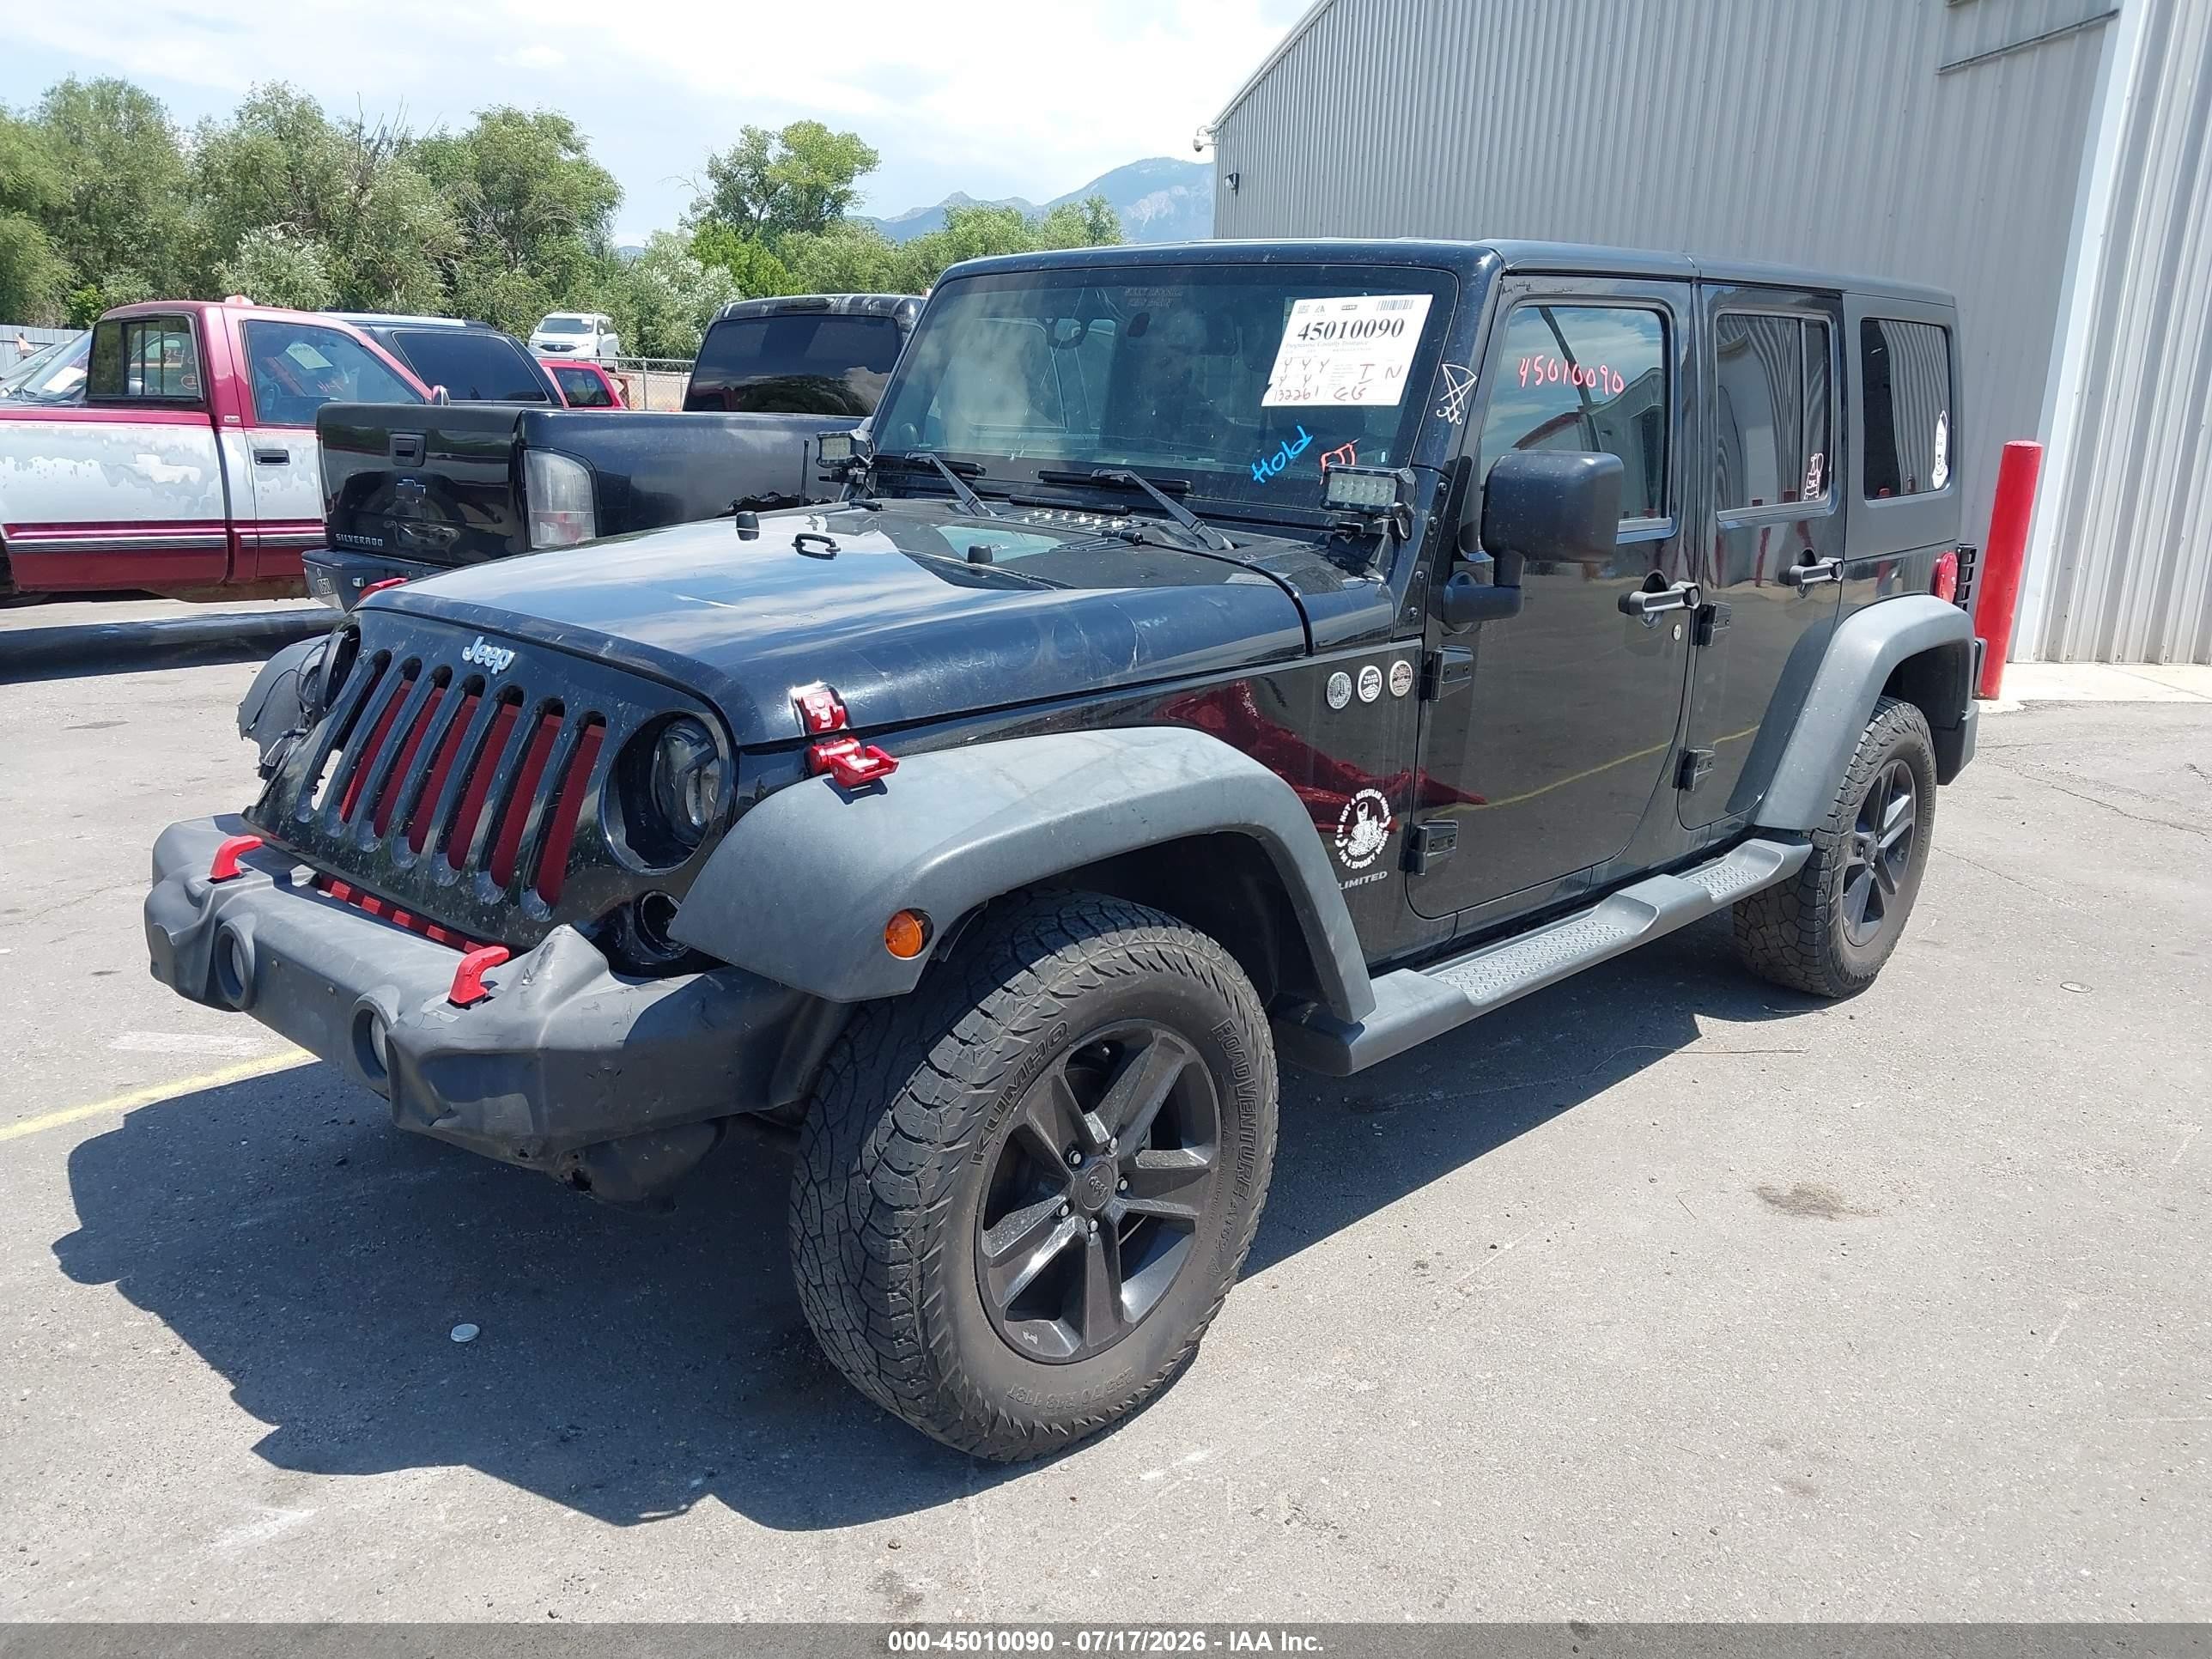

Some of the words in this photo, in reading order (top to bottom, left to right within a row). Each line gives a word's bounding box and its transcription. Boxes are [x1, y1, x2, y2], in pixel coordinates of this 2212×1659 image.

[1297, 318, 1405, 341] 45010090
[1519, 355, 1625, 396] 45010090
[1252, 425, 1314, 483] Hold
[336, 533, 384, 547] SILVERADO
[462, 635, 515, 675] Jeep
[1340, 804, 1351, 823] NOT
[1356, 788, 1382, 801] REGULAR
[1351, 853, 1376, 869] SPOOKY
[969, 1020, 1069, 1166] KUMHO
